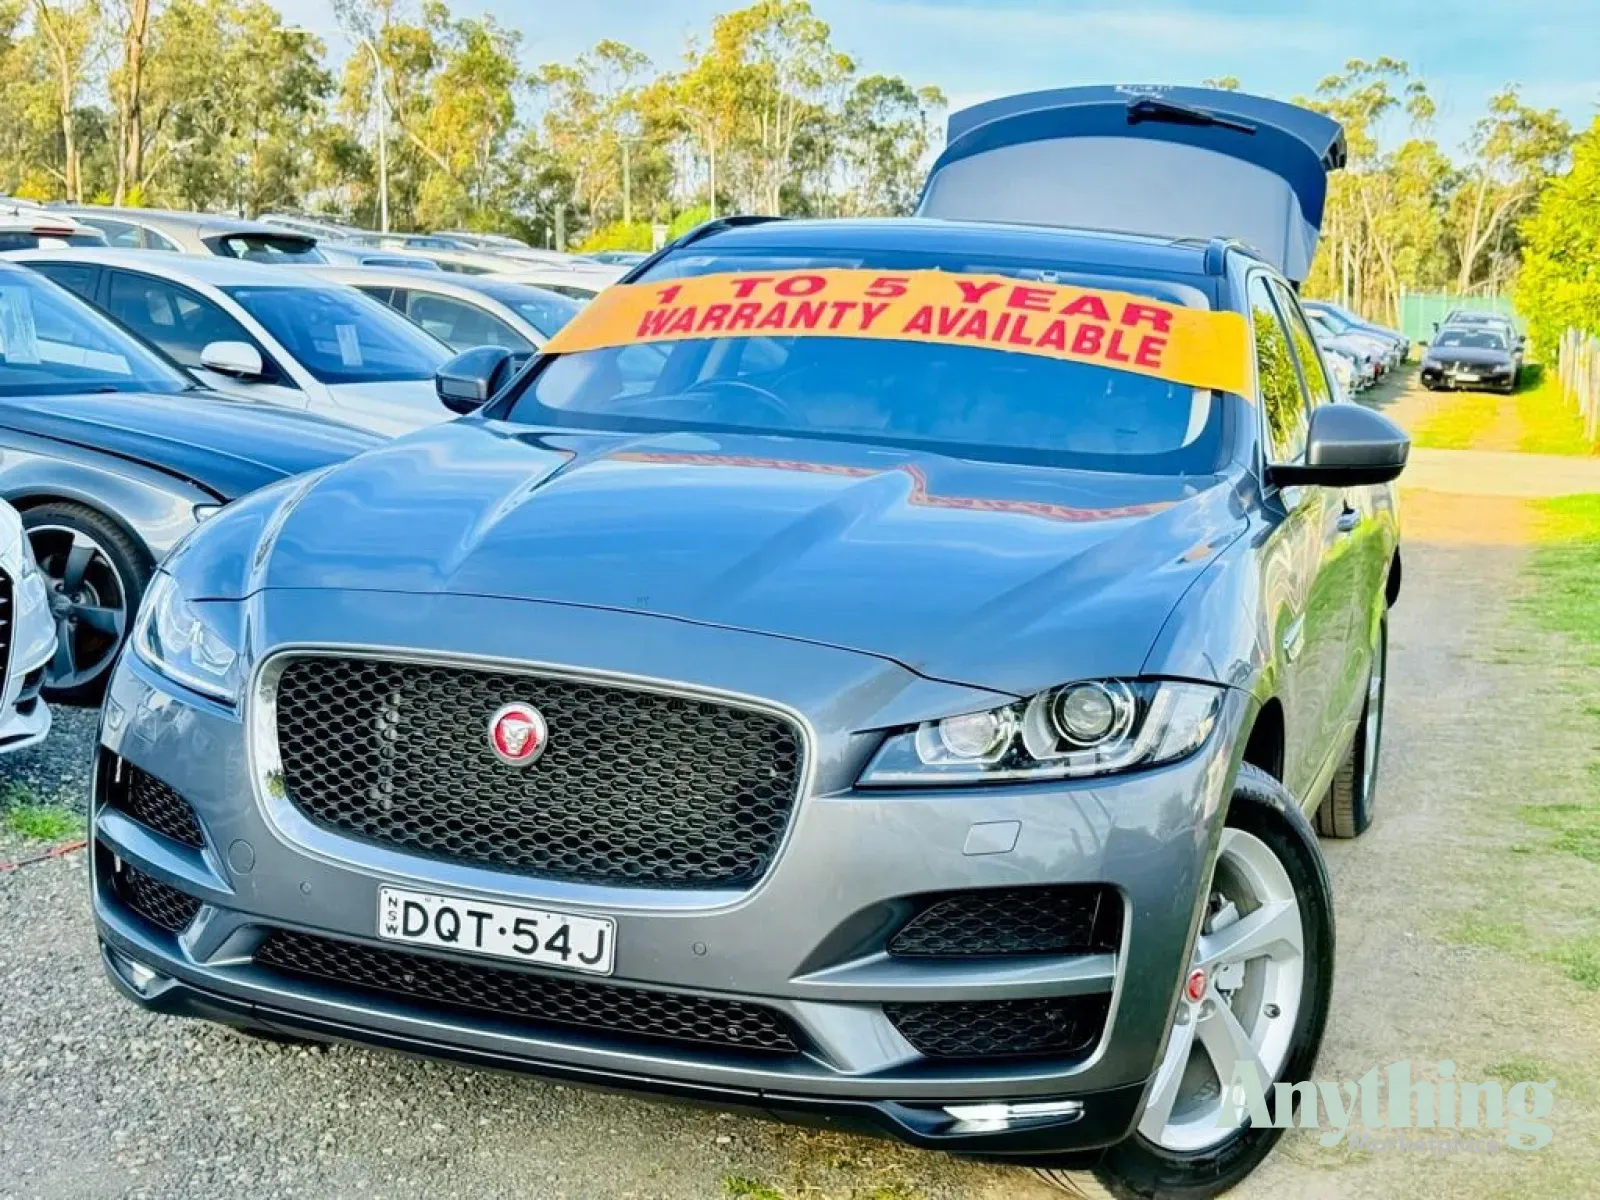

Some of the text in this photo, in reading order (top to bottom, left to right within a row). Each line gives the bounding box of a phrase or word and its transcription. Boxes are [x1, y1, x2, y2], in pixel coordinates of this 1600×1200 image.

[635, 301, 1168, 369] WARRANTY AVAILABLE
[656, 275, 1174, 334] 1 TO 5 YEAR
